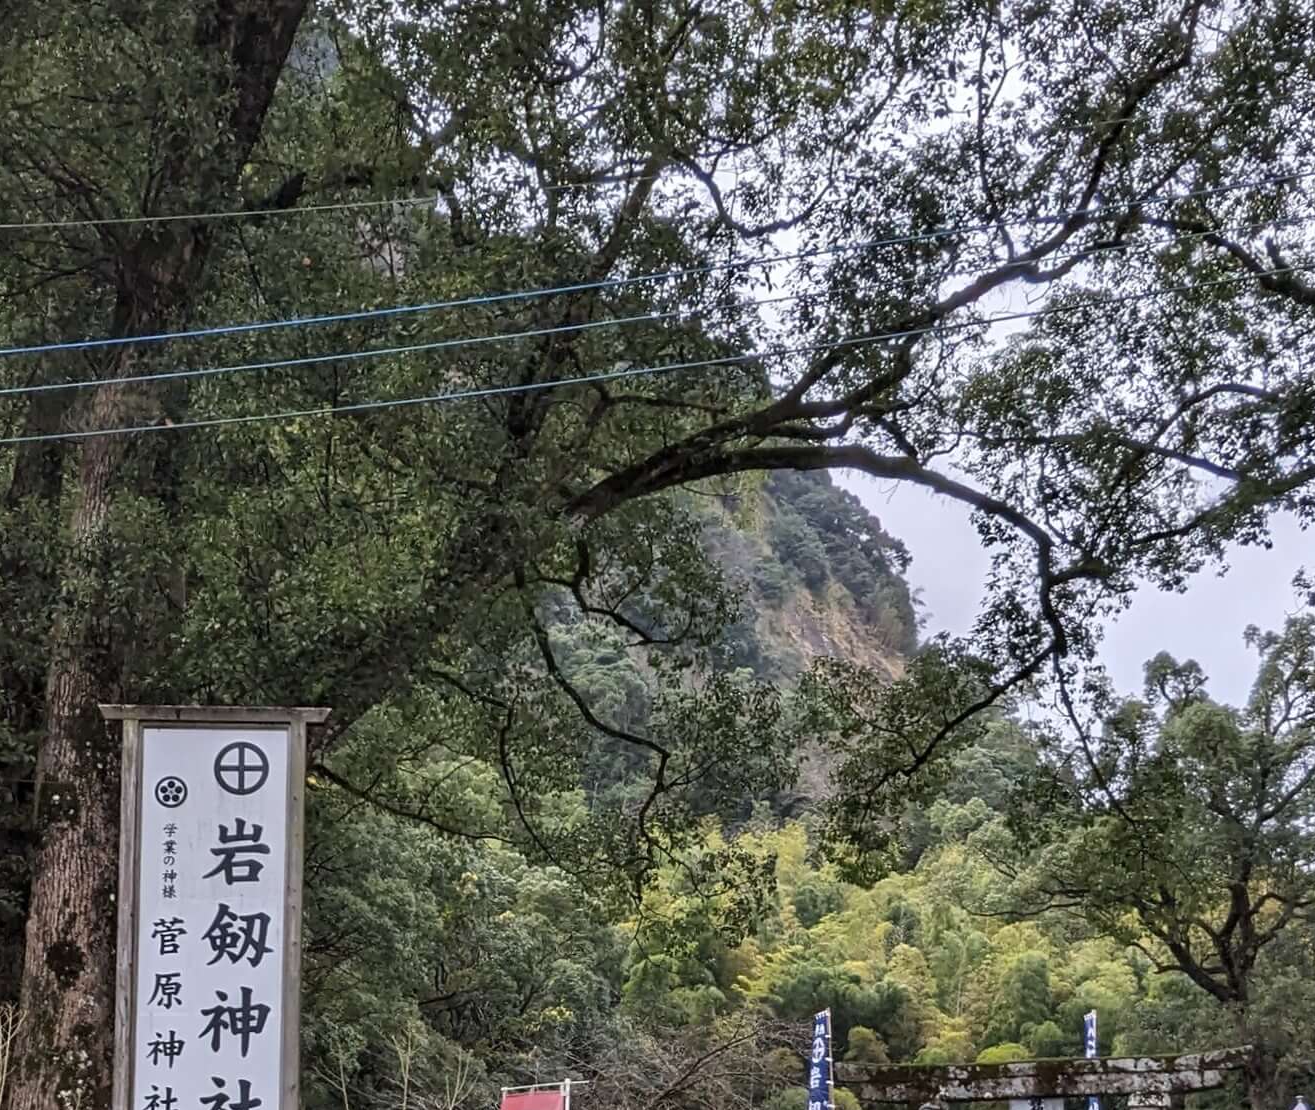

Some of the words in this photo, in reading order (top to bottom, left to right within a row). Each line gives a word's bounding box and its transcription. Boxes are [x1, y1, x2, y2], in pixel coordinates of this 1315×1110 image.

[162, 822, 178, 899] 学業の神様
